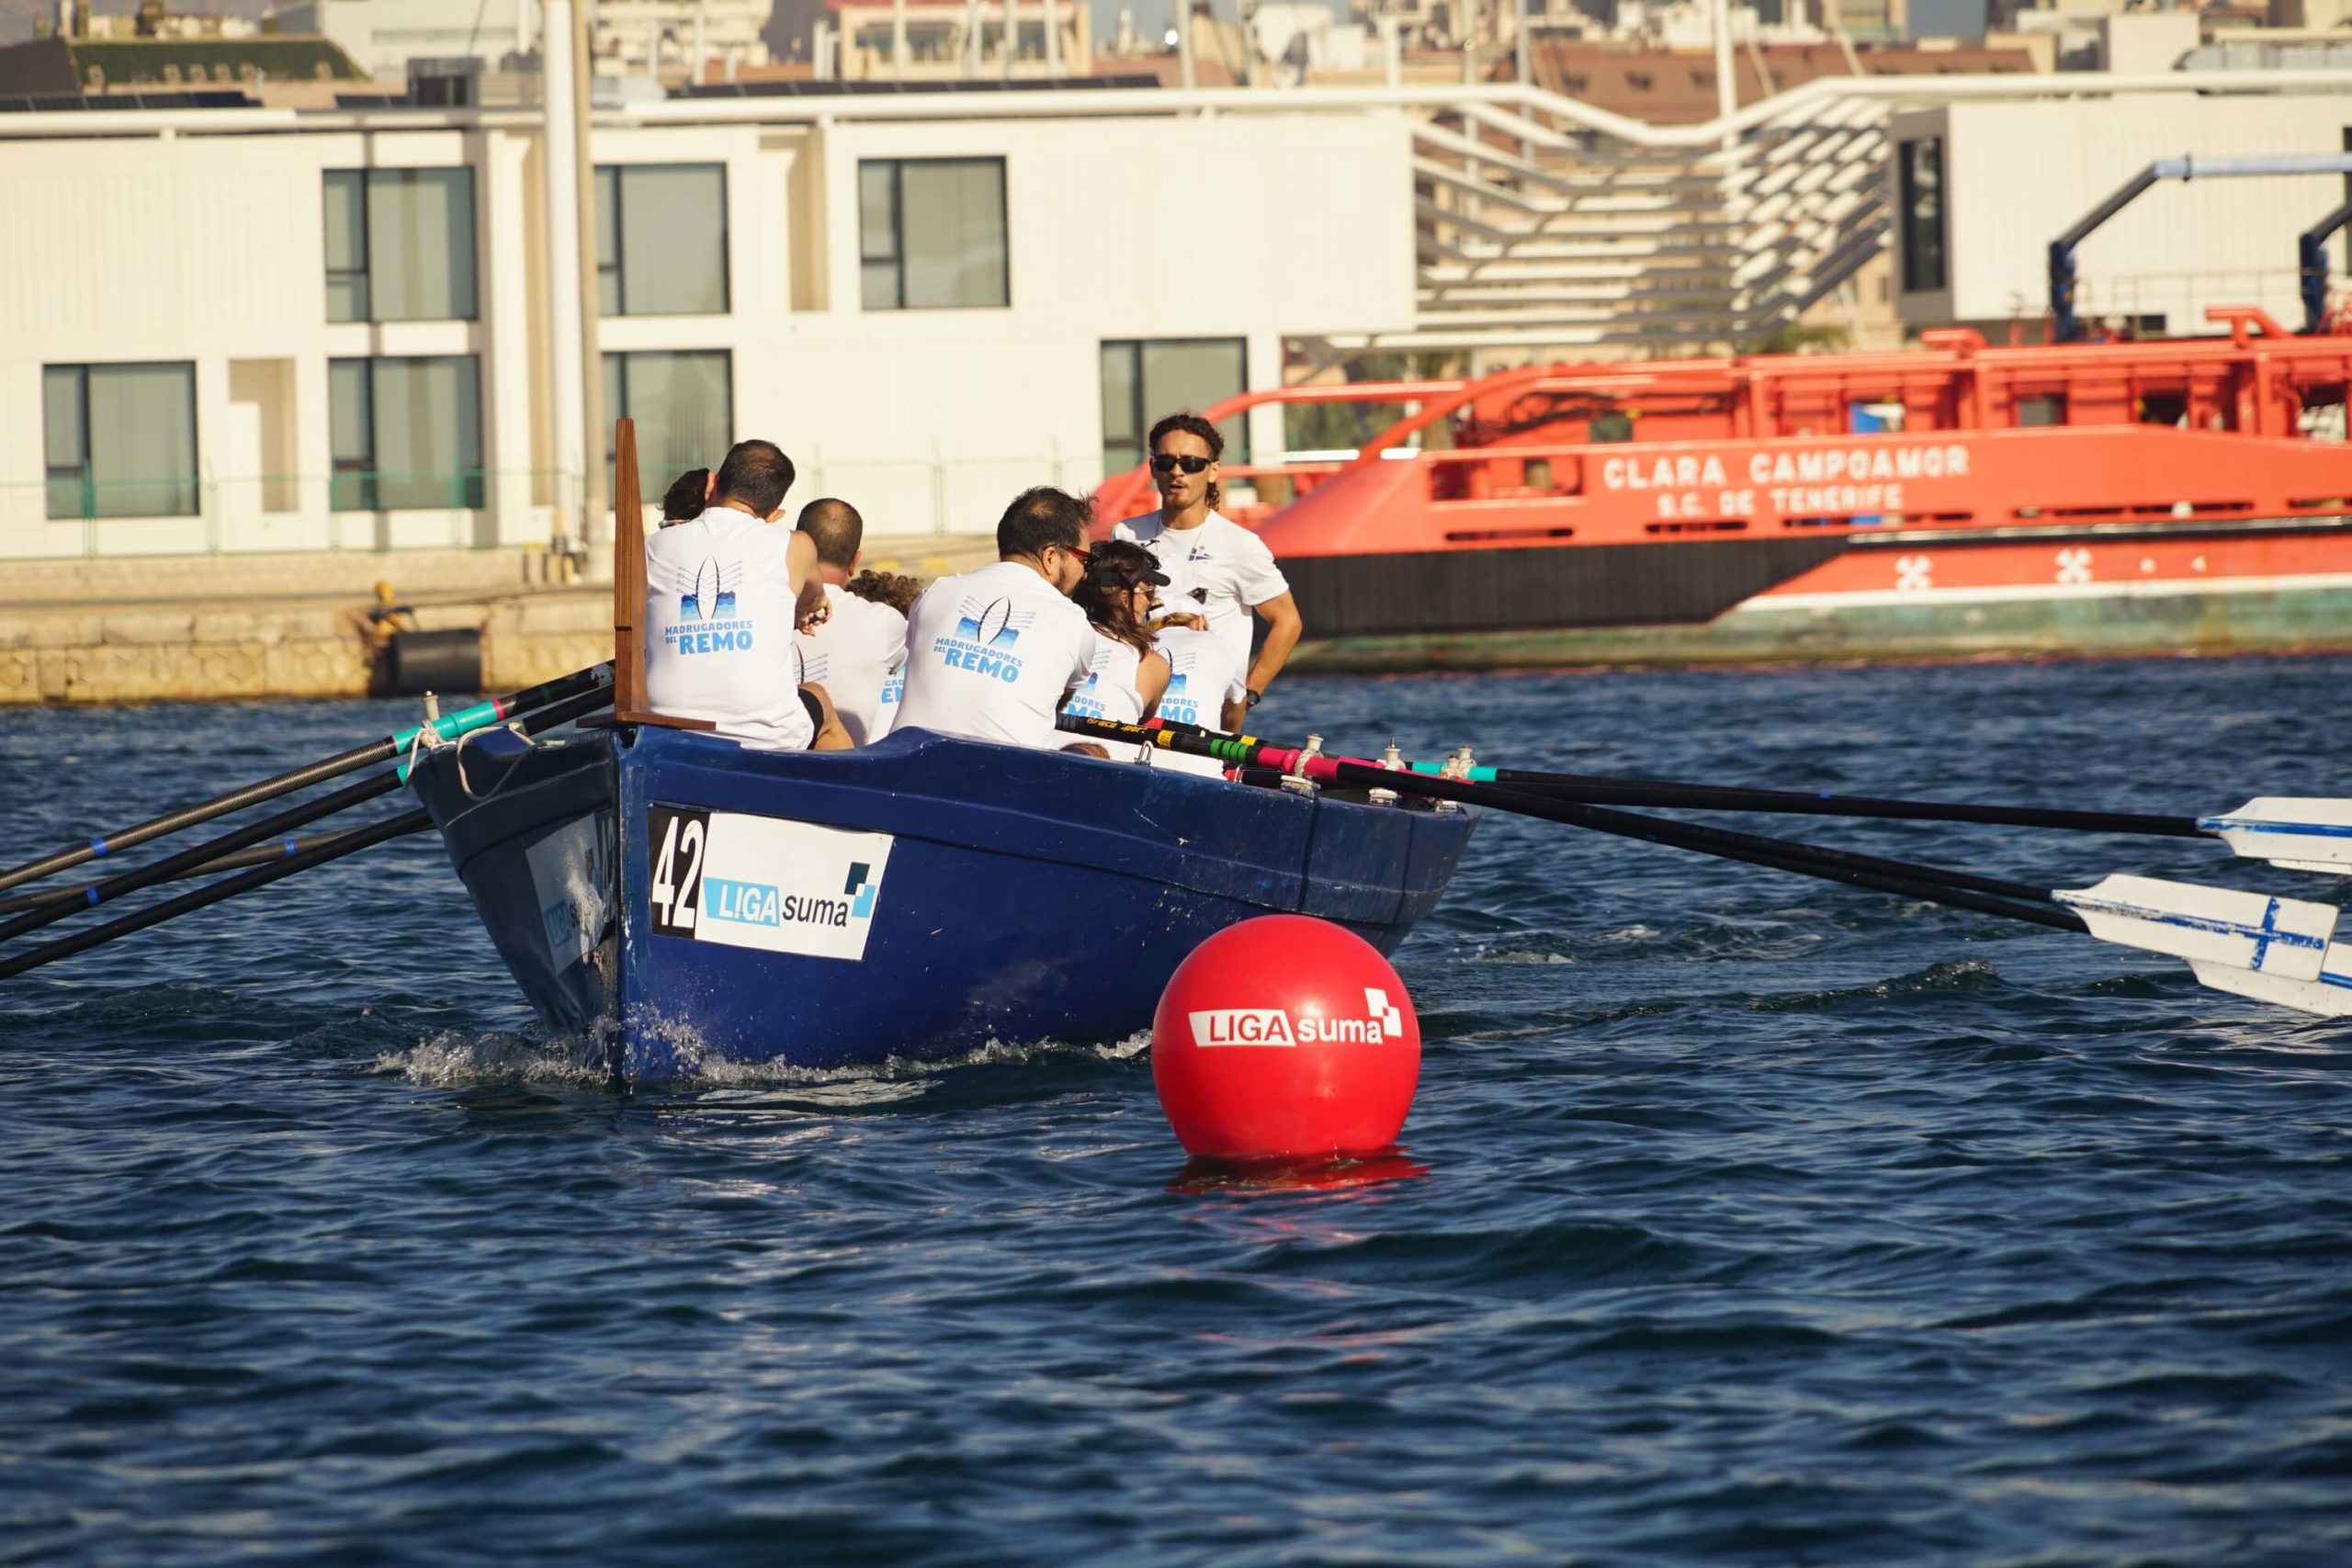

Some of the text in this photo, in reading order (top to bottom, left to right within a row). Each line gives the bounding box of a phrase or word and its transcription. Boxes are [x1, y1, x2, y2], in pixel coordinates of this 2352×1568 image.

[1603, 446, 1970, 489] CLARA CAMPOAMOR
[1719, 490, 1756, 515] DE
[1770, 483, 1904, 513] TENERIFE
[665, 621, 752, 636] MADRUGADORES
[665, 631, 752, 655] DEL REMO
[935, 637, 1023, 667] MADRUGADORES
[944, 648, 1019, 682] REMO
[651, 817, 705, 929] 42
[719, 884, 848, 927] LIGA suma
[1210, 1014, 1383, 1044] LIGA suma
